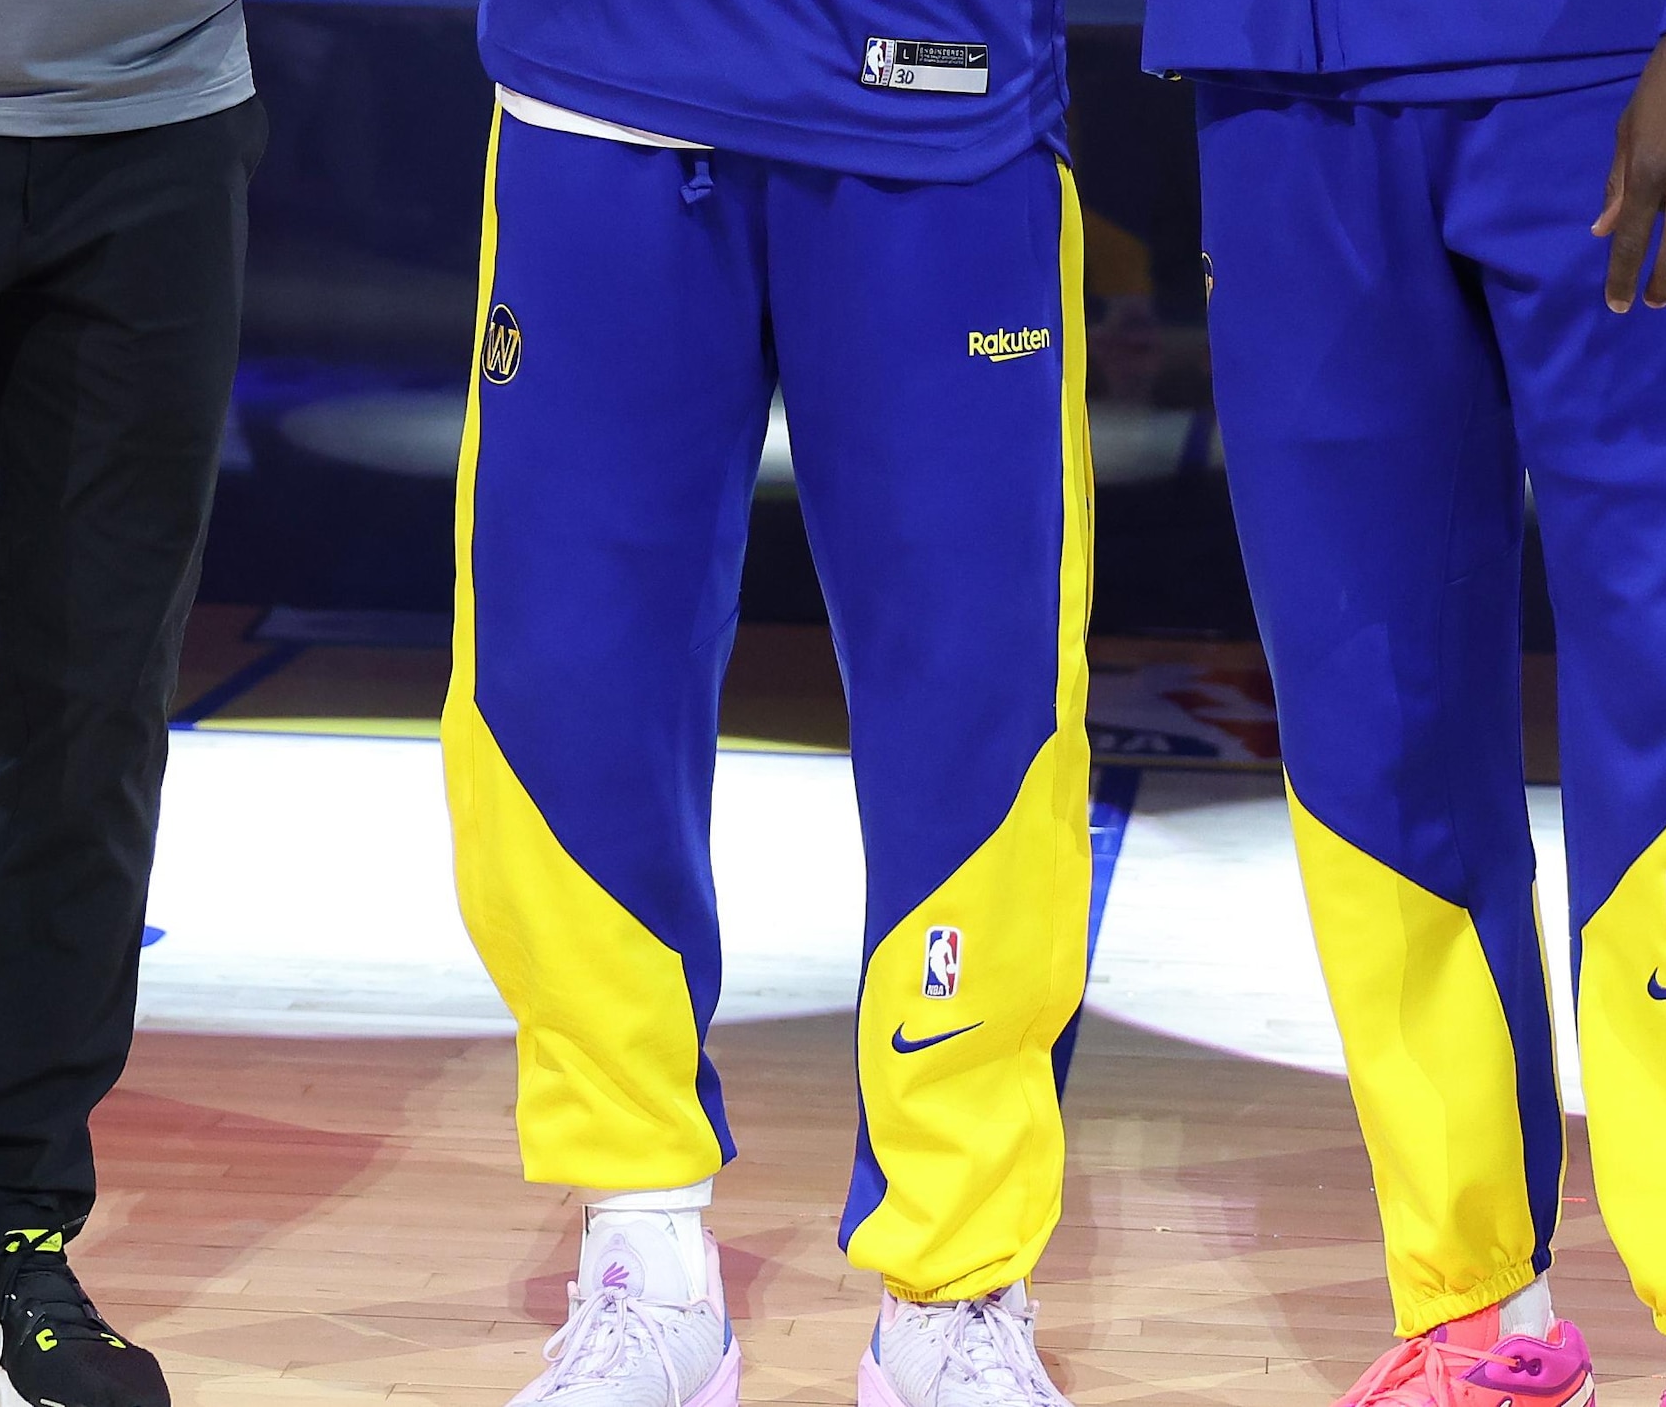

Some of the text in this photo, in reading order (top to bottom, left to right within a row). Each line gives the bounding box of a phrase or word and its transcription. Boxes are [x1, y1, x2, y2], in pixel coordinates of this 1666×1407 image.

[902, 48, 910, 60] L
[894, 68, 915, 85] 30
[968, 327, 1050, 363] Rakuten
